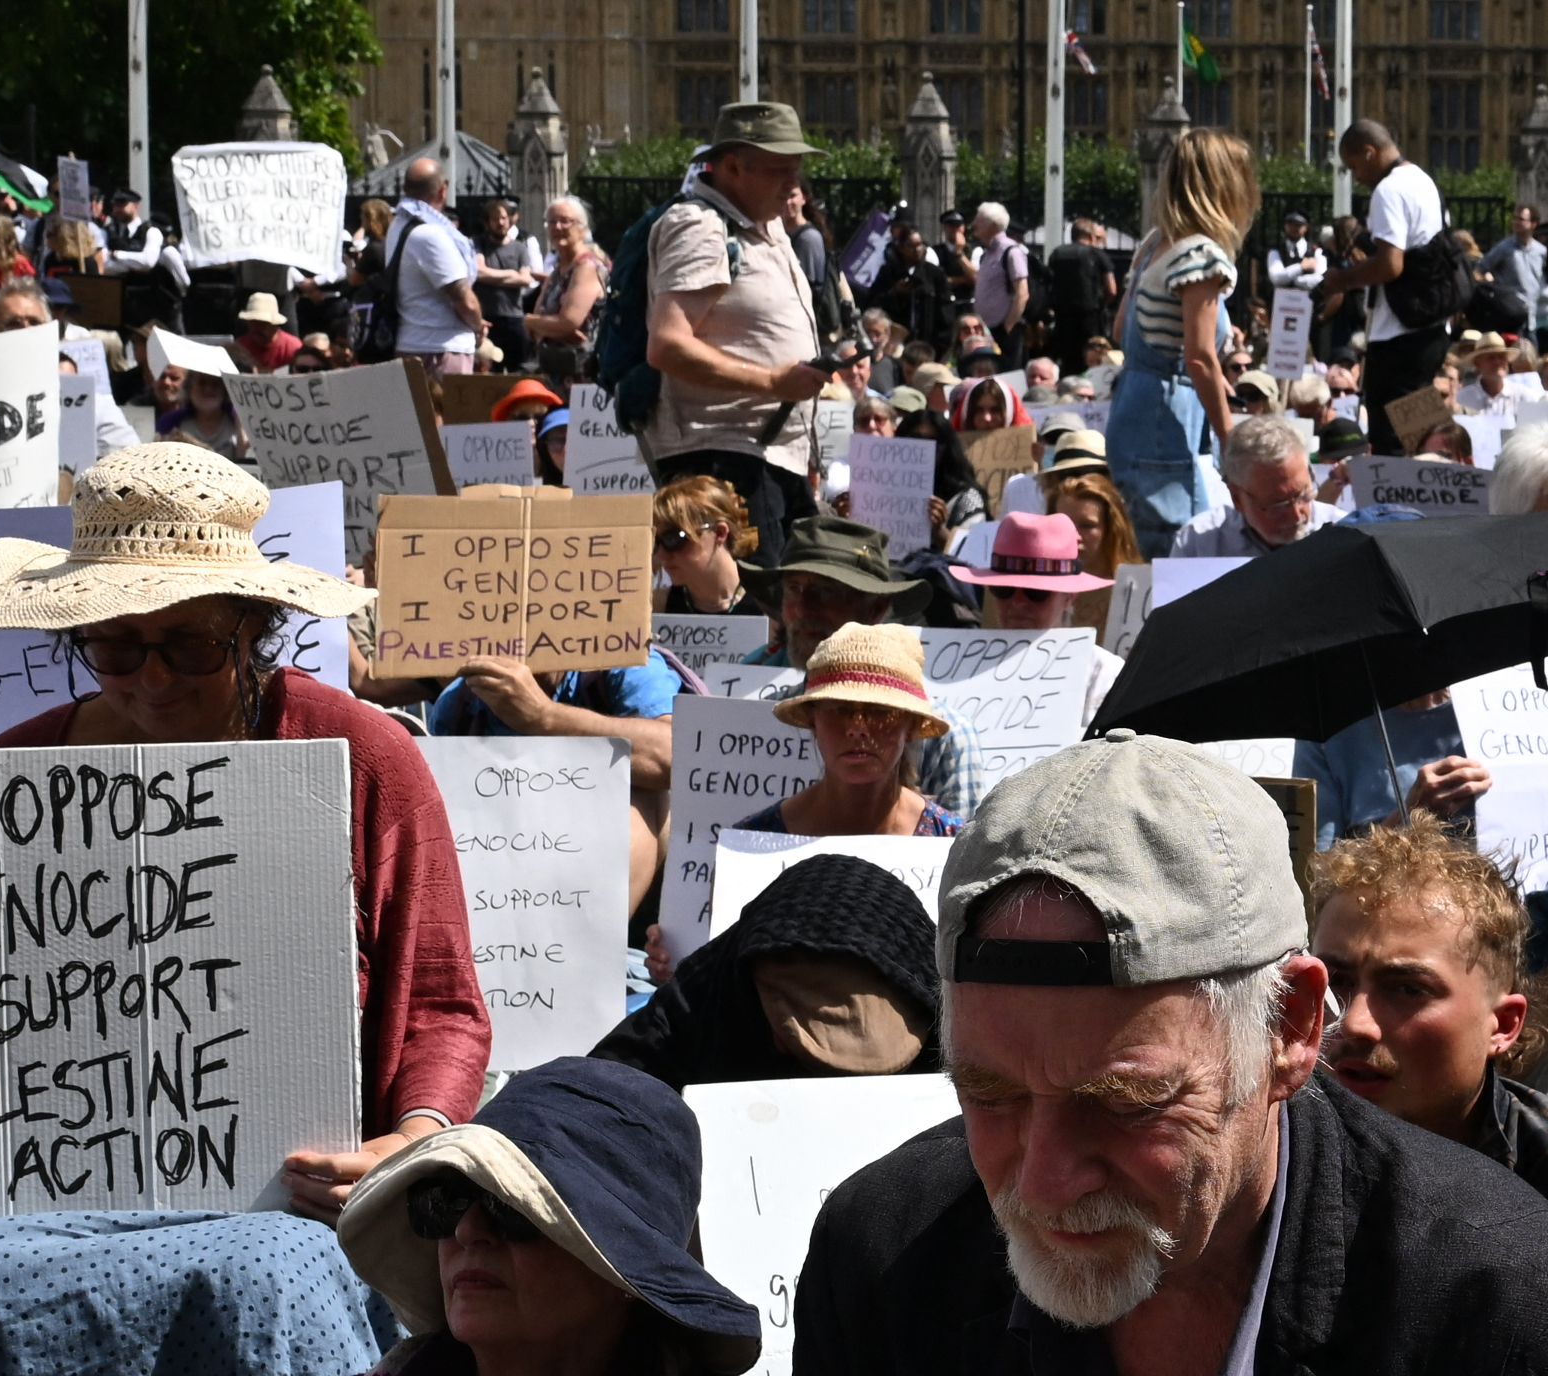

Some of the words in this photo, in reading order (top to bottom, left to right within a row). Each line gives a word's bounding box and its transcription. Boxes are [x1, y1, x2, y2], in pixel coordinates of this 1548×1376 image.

[229, 378, 330, 412] OPPOSE
[248, 415, 372, 445] GENOCIDE
[463, 436, 524, 463] OPPOSE
[870, 442, 926, 464] OPPOSE
[266, 450, 421, 495] SUPPORT
[853, 468, 926, 488] GENOCIDE
[1417, 467, 1486, 489] OPPOSE
[1374, 484, 1479, 505] GENOCIDE
[402, 534, 425, 557] I
[455, 535, 611, 562] OPPOSE
[444, 567, 642, 594] GENOCIDE
[402, 602, 429, 622] I
[459, 599, 621, 623] SUPPORT
[379, 630, 523, 662] PALESTINE
[931, 636, 1089, 682] OPPOSE
[719, 733, 810, 760] OPPOSE
[475, 767, 595, 797] OPPOSE
[474, 889, 589, 910] SUPPORT
[7, 1114, 238, 1201] ACTION
